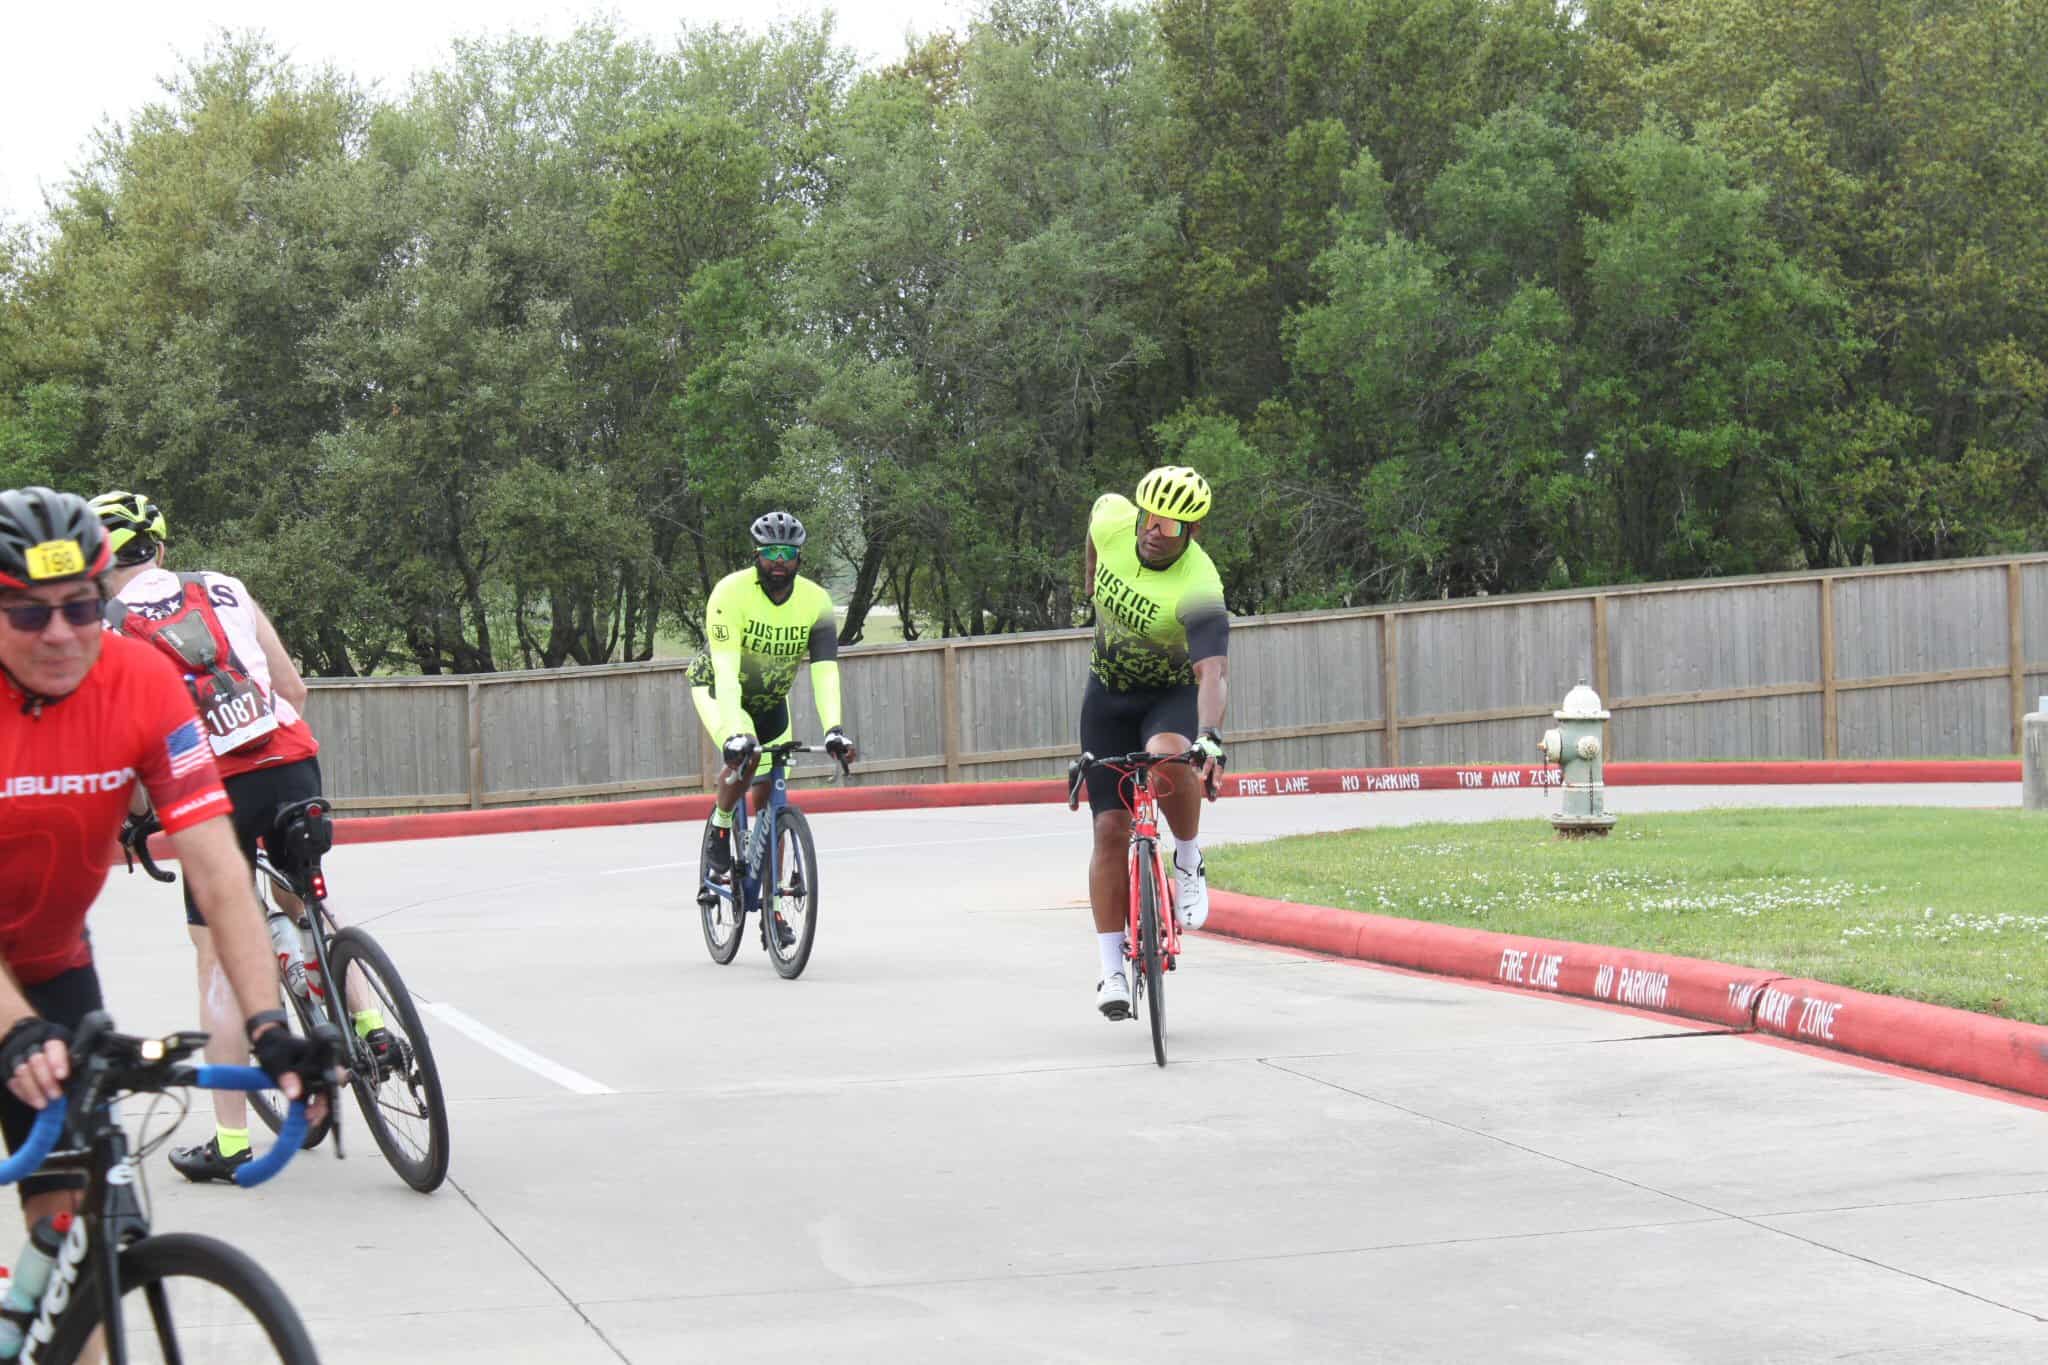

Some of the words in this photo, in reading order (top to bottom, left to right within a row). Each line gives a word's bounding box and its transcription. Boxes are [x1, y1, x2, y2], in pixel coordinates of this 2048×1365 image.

[1096, 585, 1152, 633] EAGUE
[742, 635, 806, 656] LEAGUE
[744, 619, 808, 641] JUSTICE
[206, 692, 258, 734] 1087
[0, 767, 135, 799] IBURTO
[1238, 778, 1268, 796] FIRE
[1275, 776, 1310, 793] LANE
[1341, 775, 1360, 791] NO
[1367, 773, 1420, 790] PARKING
[1456, 771, 1482, 787] TOW
[1491, 770, 1520, 786] AWAY
[1529, 769, 1562, 785] ZONE
[1499, 948, 1527, 982] FIRE
[1529, 952, 1563, 988] LANE
[1594, 964, 1614, 997] NO
[1617, 967, 1669, 1008] PARKING
[1798, 997, 1843, 1039] ZONE
